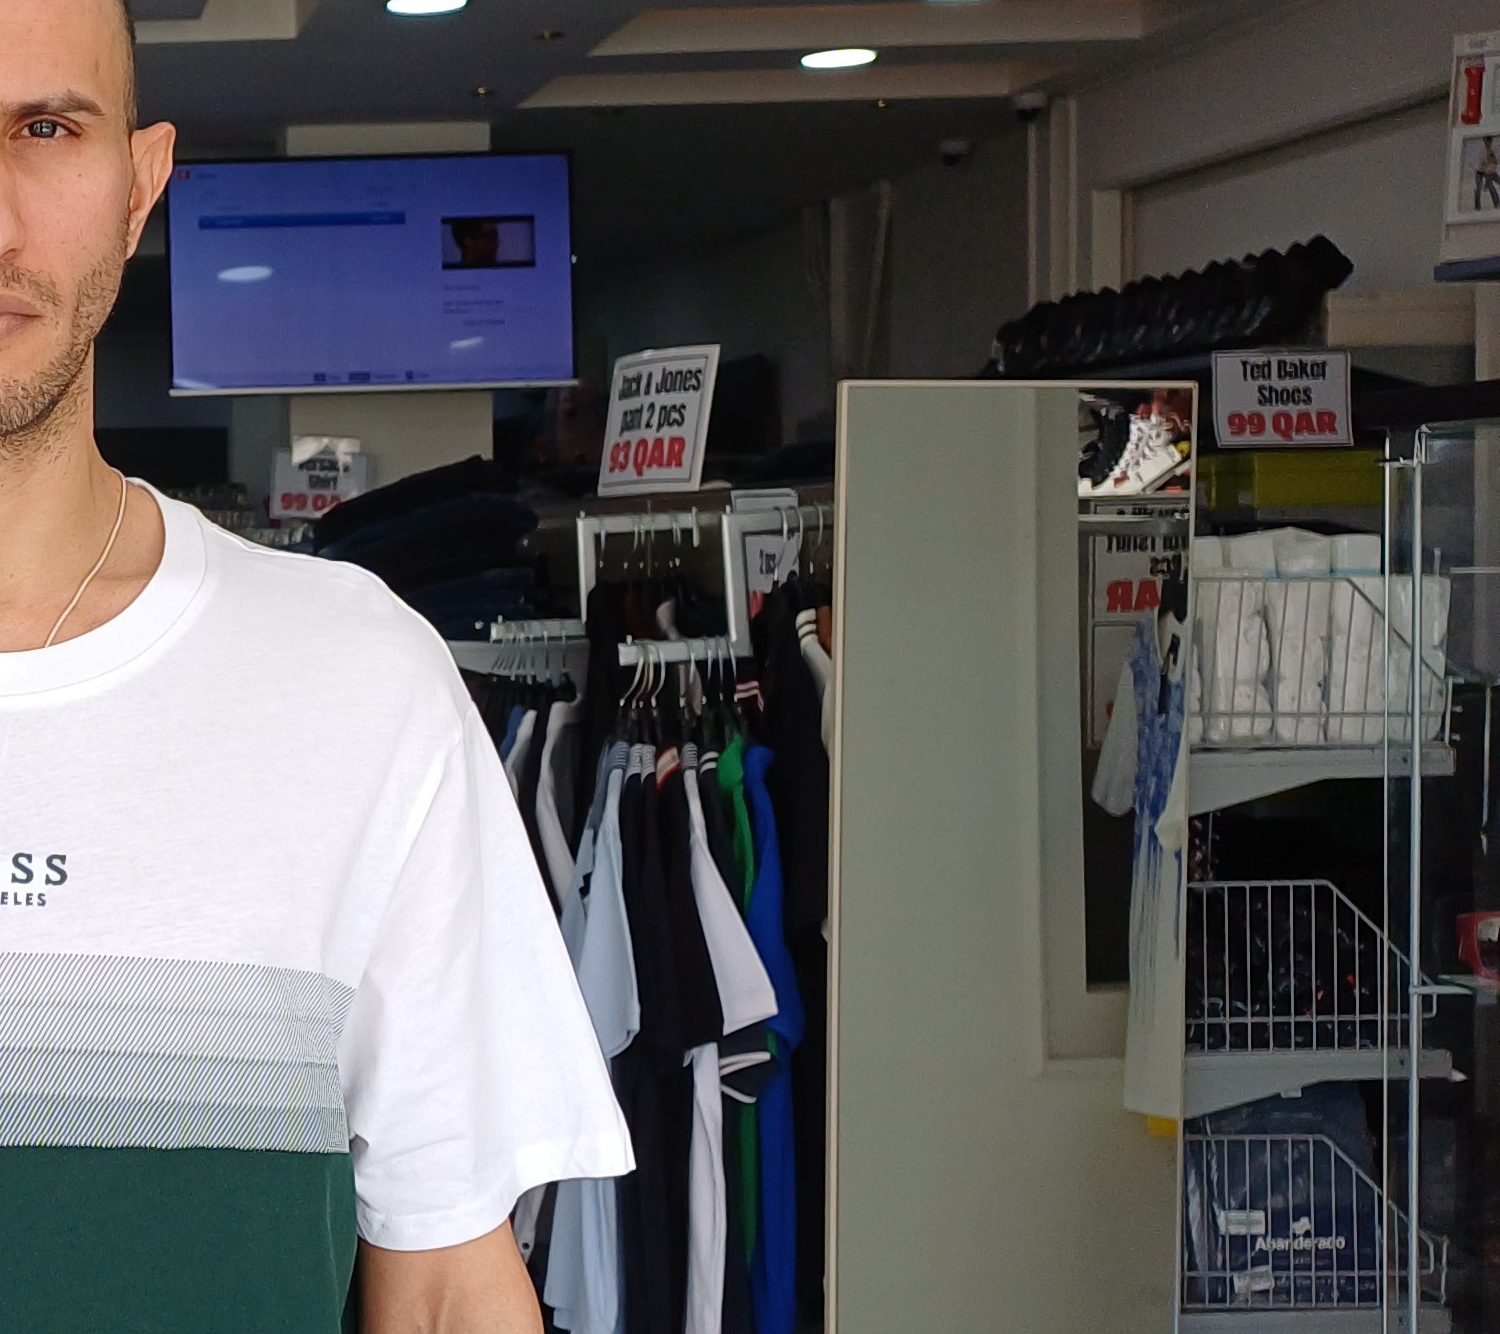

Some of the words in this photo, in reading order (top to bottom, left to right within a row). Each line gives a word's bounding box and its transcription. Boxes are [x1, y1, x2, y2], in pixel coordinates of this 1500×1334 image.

[655, 366, 704, 395] Jones
[1240, 359, 1271, 381] Ted
[1277, 359, 1328, 381] Baker
[1257, 385, 1313, 406] Shoes
[645, 402, 656, 429] 2
[656, 403, 687, 433] pcs
[1227, 411, 1266, 436] 99
[1271, 410, 1338, 441] QAR
[632, 436, 687, 477] QAR
[280, 493, 308, 511] 99
